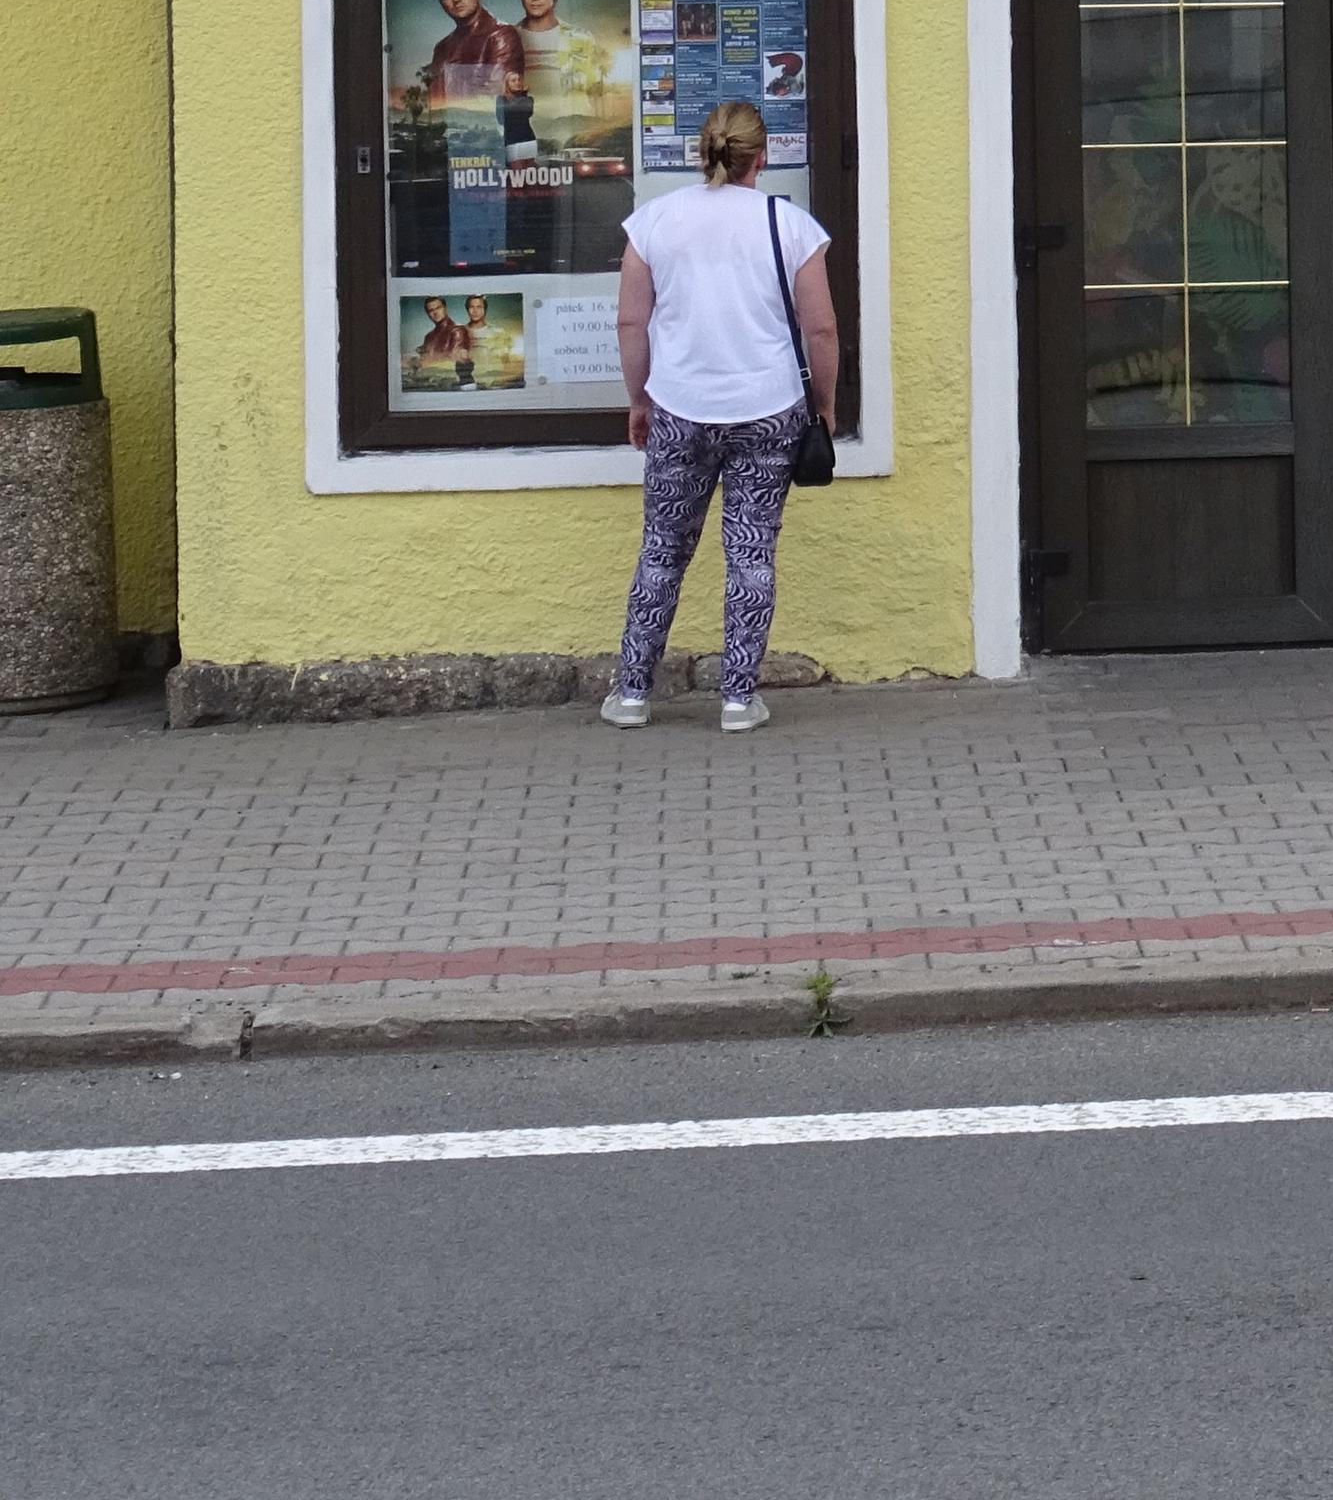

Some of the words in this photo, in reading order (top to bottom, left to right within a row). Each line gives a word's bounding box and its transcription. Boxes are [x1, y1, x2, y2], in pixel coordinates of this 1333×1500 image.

[453, 166, 574, 190] HOLLYWOODU
[572, 321, 601, 332] 19.00
[554, 345, 588, 355] sobota
[573, 364, 602, 374] 19.00
